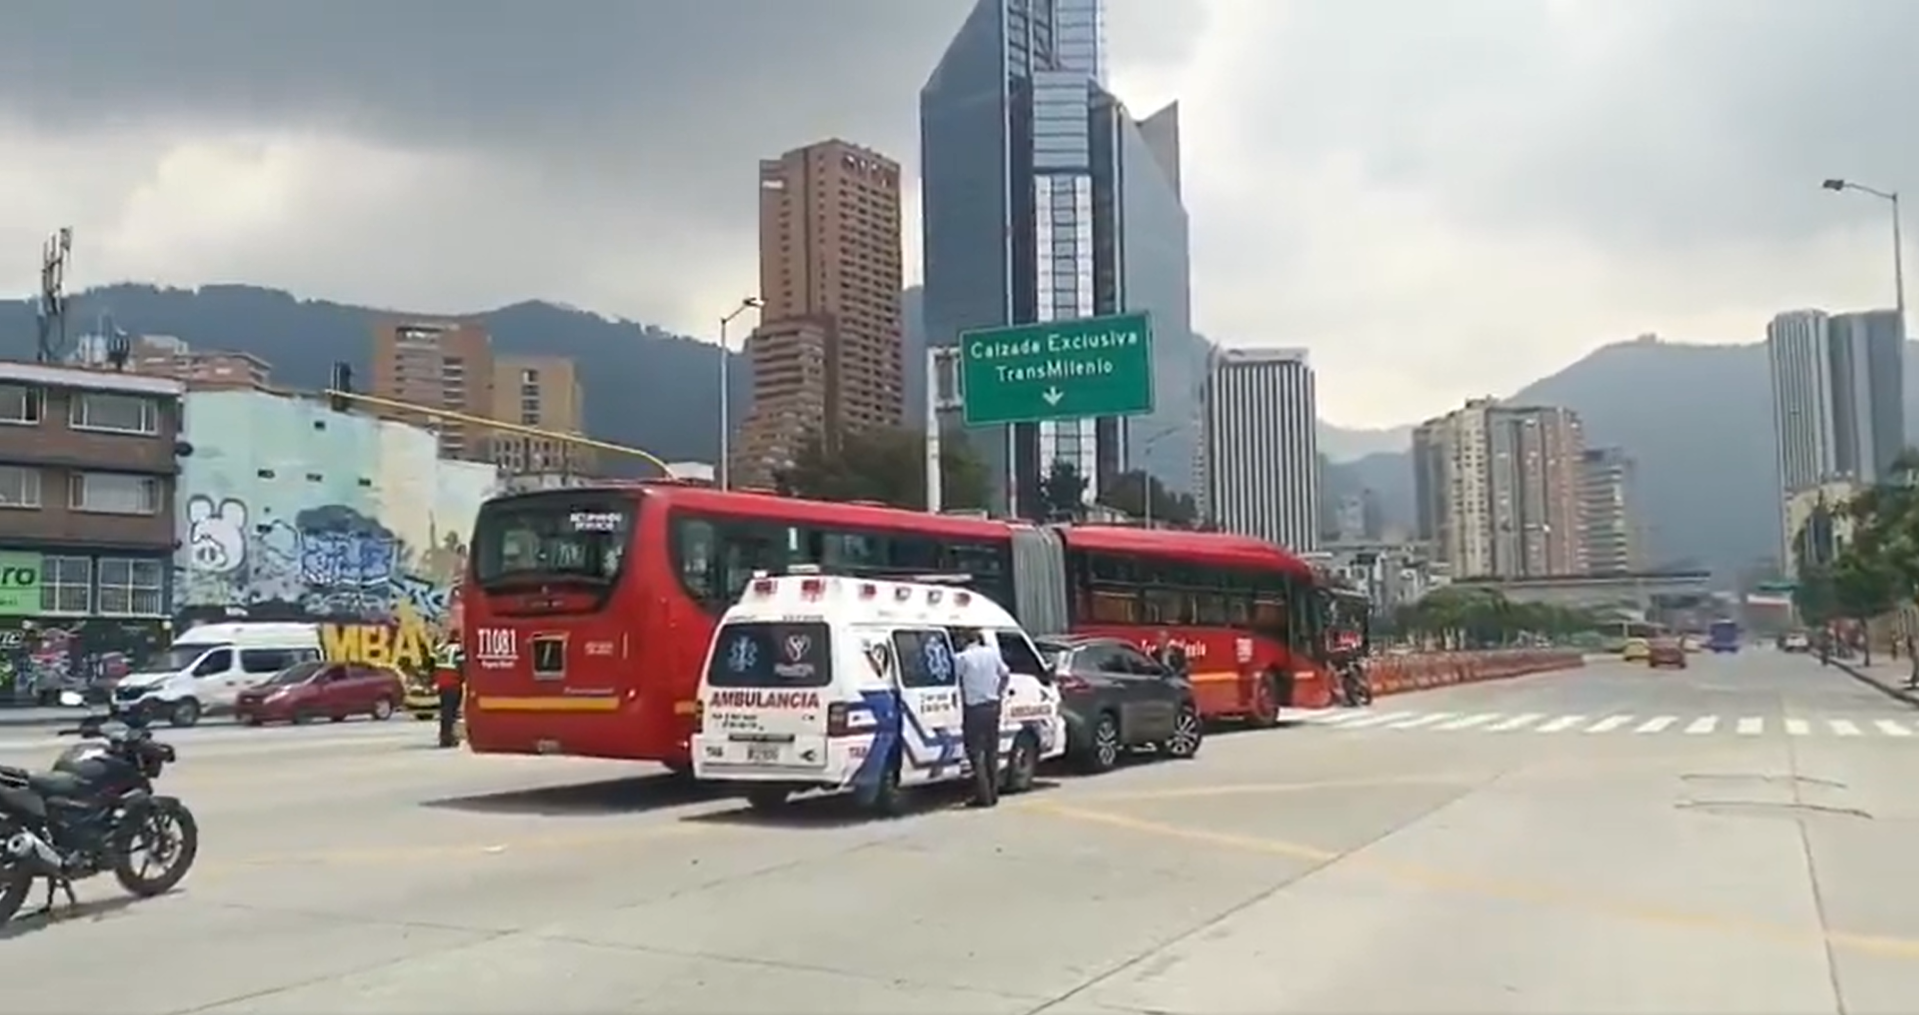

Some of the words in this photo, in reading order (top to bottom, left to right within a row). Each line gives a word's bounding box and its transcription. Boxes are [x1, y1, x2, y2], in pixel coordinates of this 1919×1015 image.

[970, 339, 1041, 359] Calzada
[1047, 331, 1138, 352] Exclusiva
[996, 357, 1113, 383] TransMilenio
[477, 628, 517, 656] T1081
[709, 691, 820, 709] AMBULANCIA
